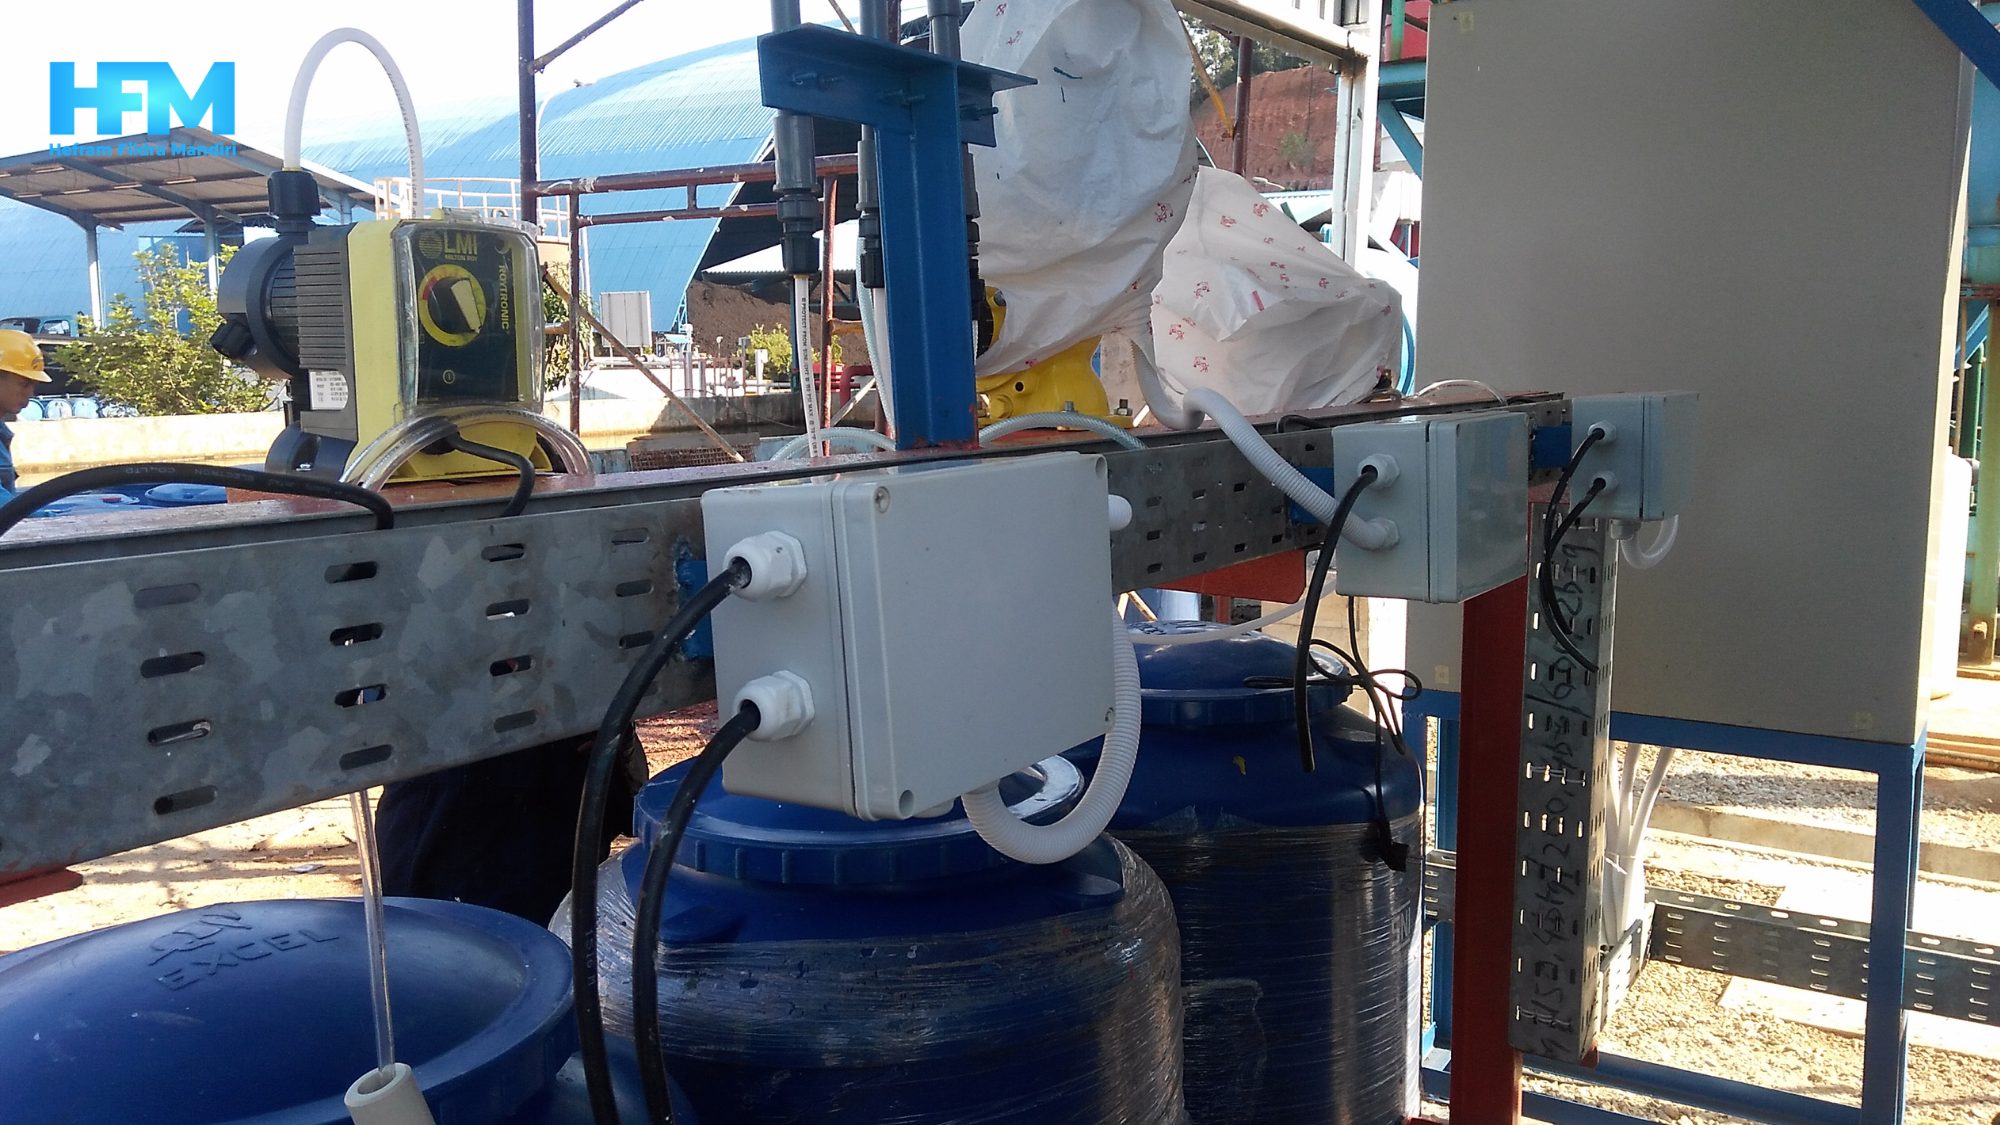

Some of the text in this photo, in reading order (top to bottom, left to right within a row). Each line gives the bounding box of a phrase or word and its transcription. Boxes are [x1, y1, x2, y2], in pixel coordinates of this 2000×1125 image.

[445, 232, 478, 255] LMI
[498, 265, 510, 330] ROYTRONIC
[195, 469, 254, 481] ELECTRON
[156, 929, 341, 991] EXCEL
